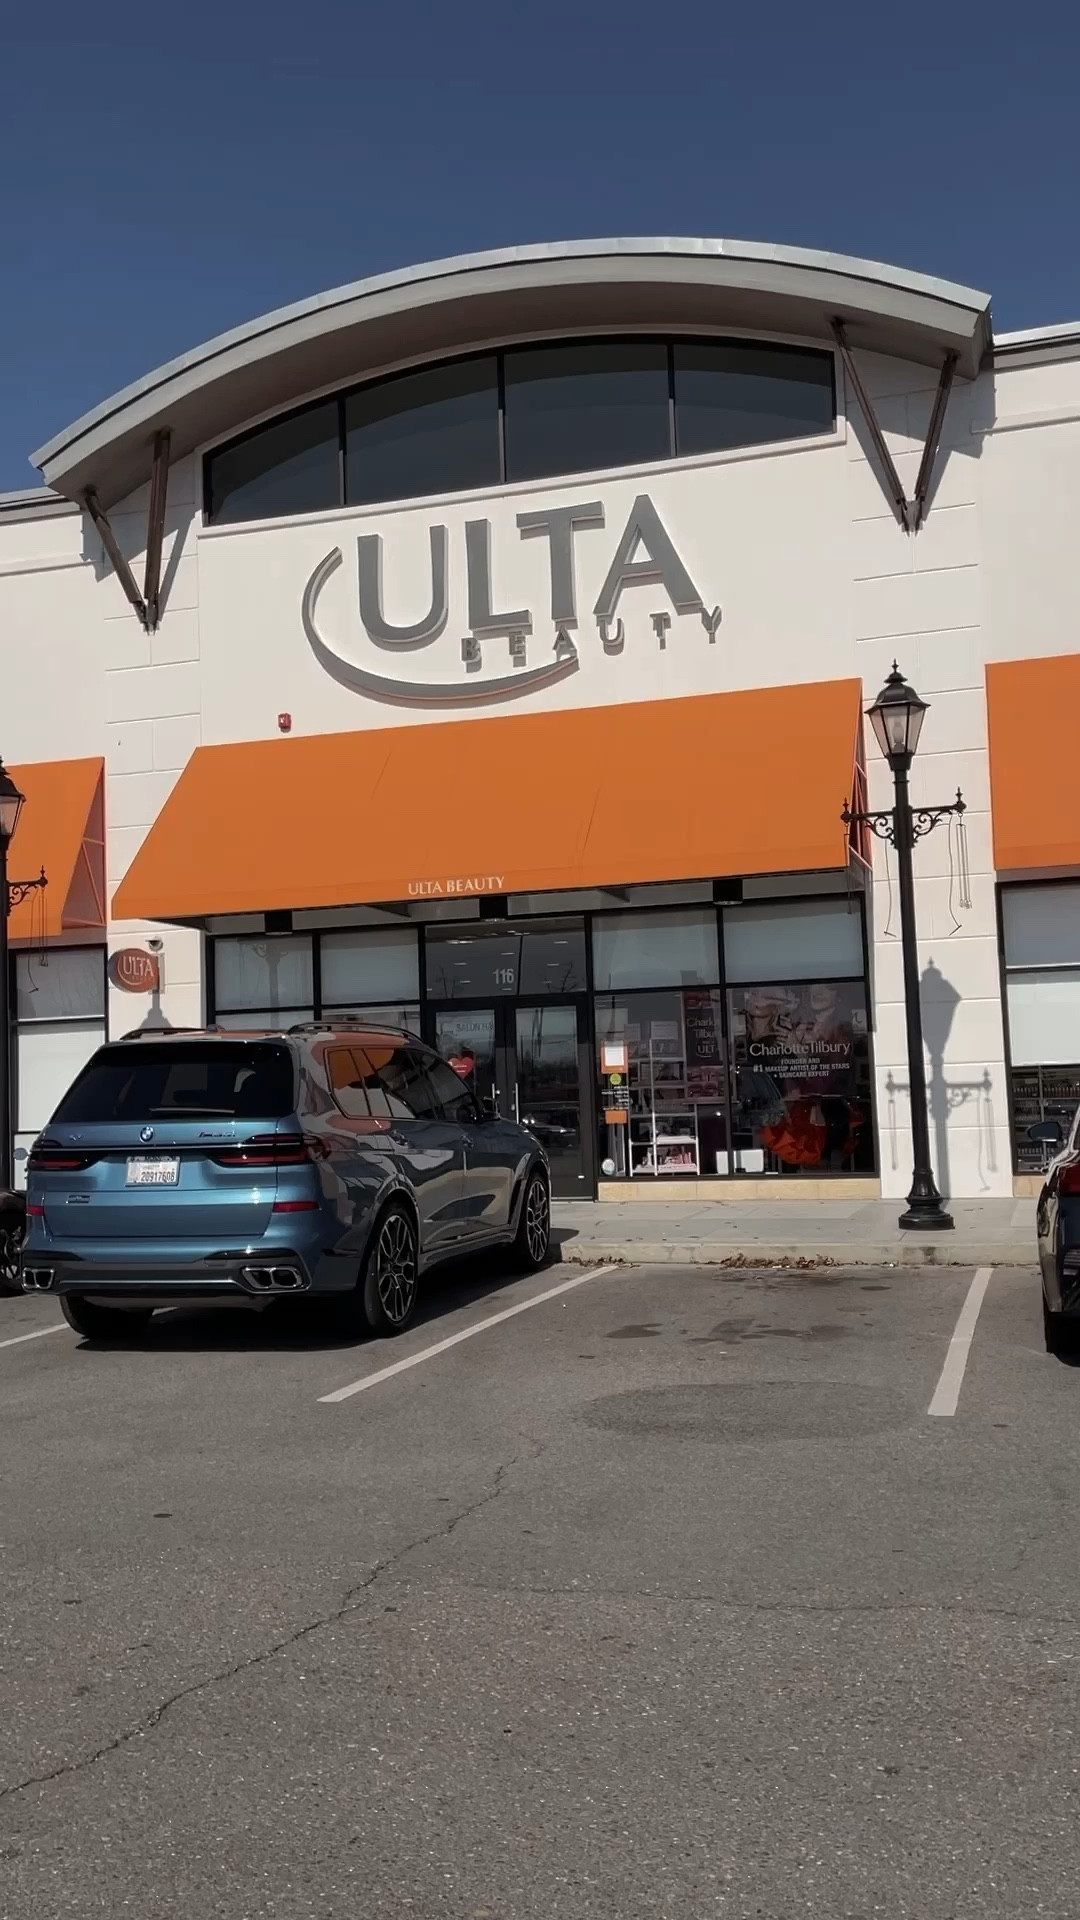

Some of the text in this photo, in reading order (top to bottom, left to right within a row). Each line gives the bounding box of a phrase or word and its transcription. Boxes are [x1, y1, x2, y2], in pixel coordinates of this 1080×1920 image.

[356, 494, 704, 648] ULTA
[460, 605, 722, 668] BEAUTY
[408, 876, 505, 895] ULTA BEAUTY
[122, 955, 155, 977] ULTA
[492, 968, 515, 985] 116
[697, 1045, 716, 1054] ULT
[749, 1040, 851, 1057] Charlotte Tilbury
[753, 1064, 763, 1073] #1
[819, 1063, 830, 1071] THE
